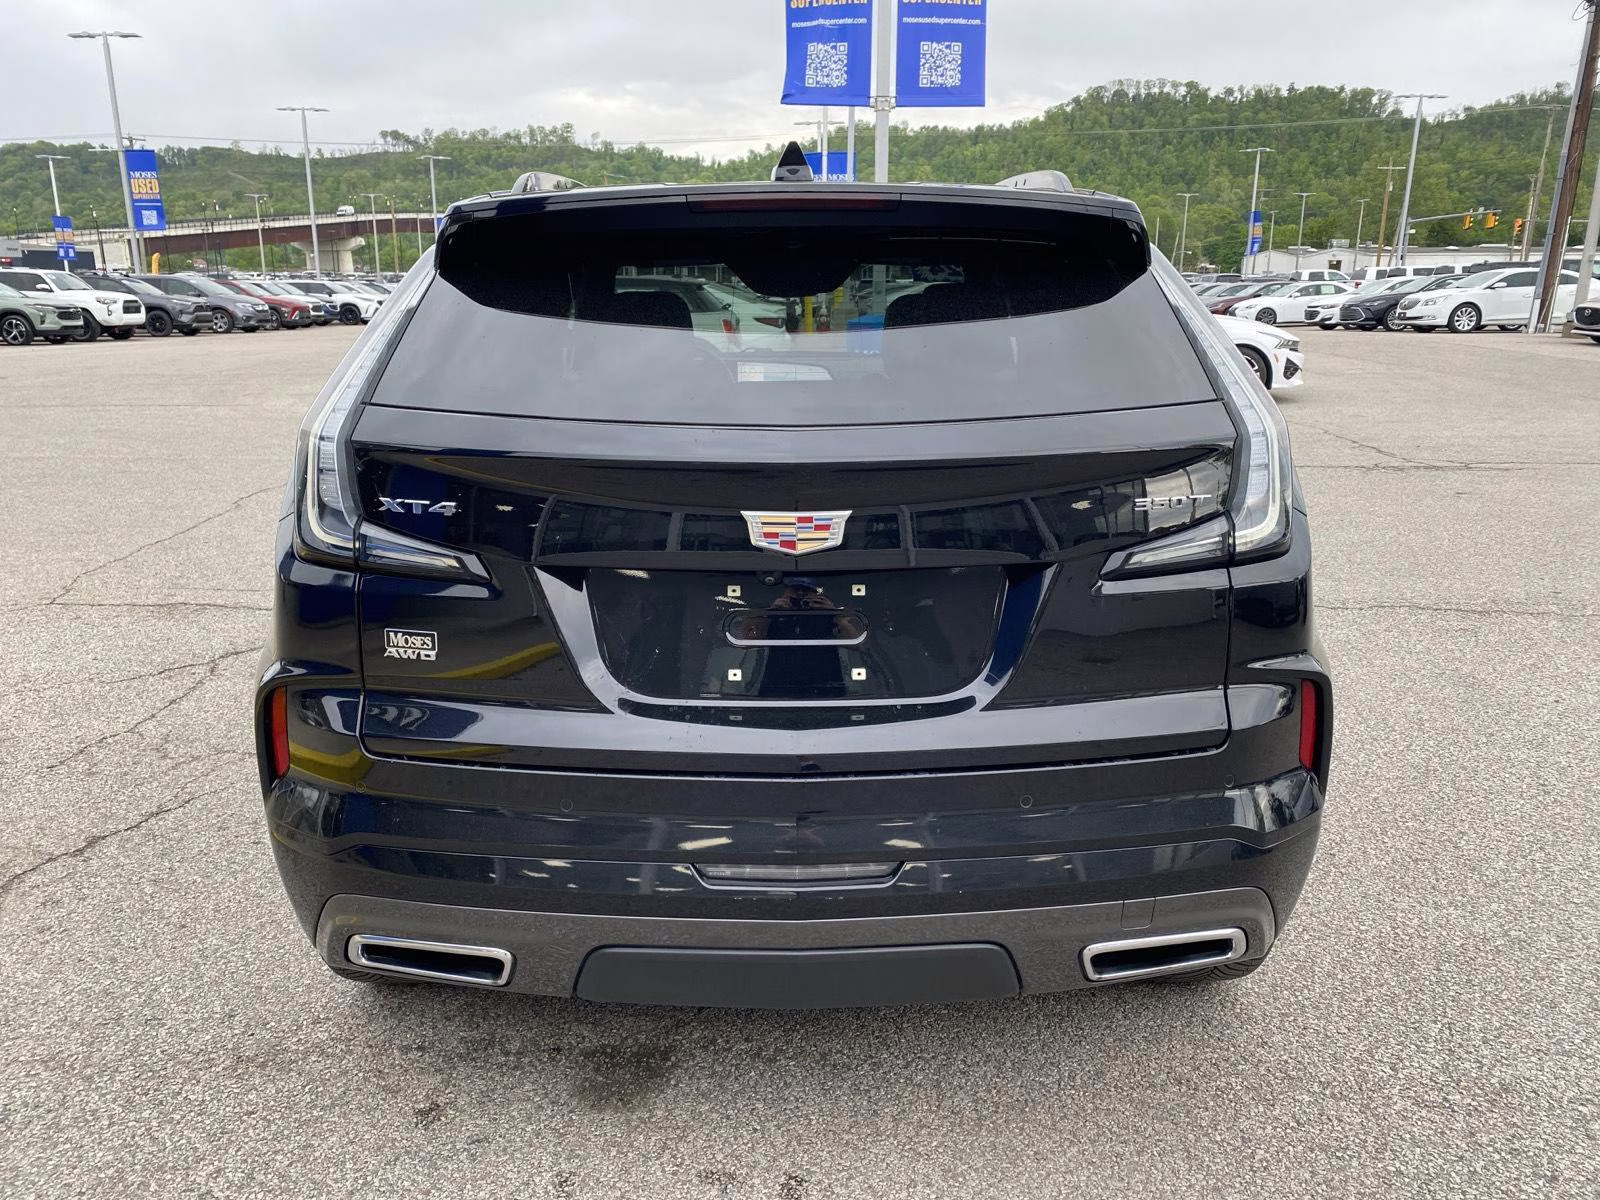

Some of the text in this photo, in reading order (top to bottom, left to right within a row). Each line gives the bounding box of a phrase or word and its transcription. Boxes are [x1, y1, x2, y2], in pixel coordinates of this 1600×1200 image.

[792, 18, 867, 28] mosesusedsupercenter.com
[902, 16, 981, 25] mosesusedsupercenter.com
[131, 179, 159, 193] USED
[378, 497, 457, 516] XT4
[1134, 494, 1212, 511] 350T
[389, 632, 433, 649] MOSES
[384, 648, 437, 661] AWD
